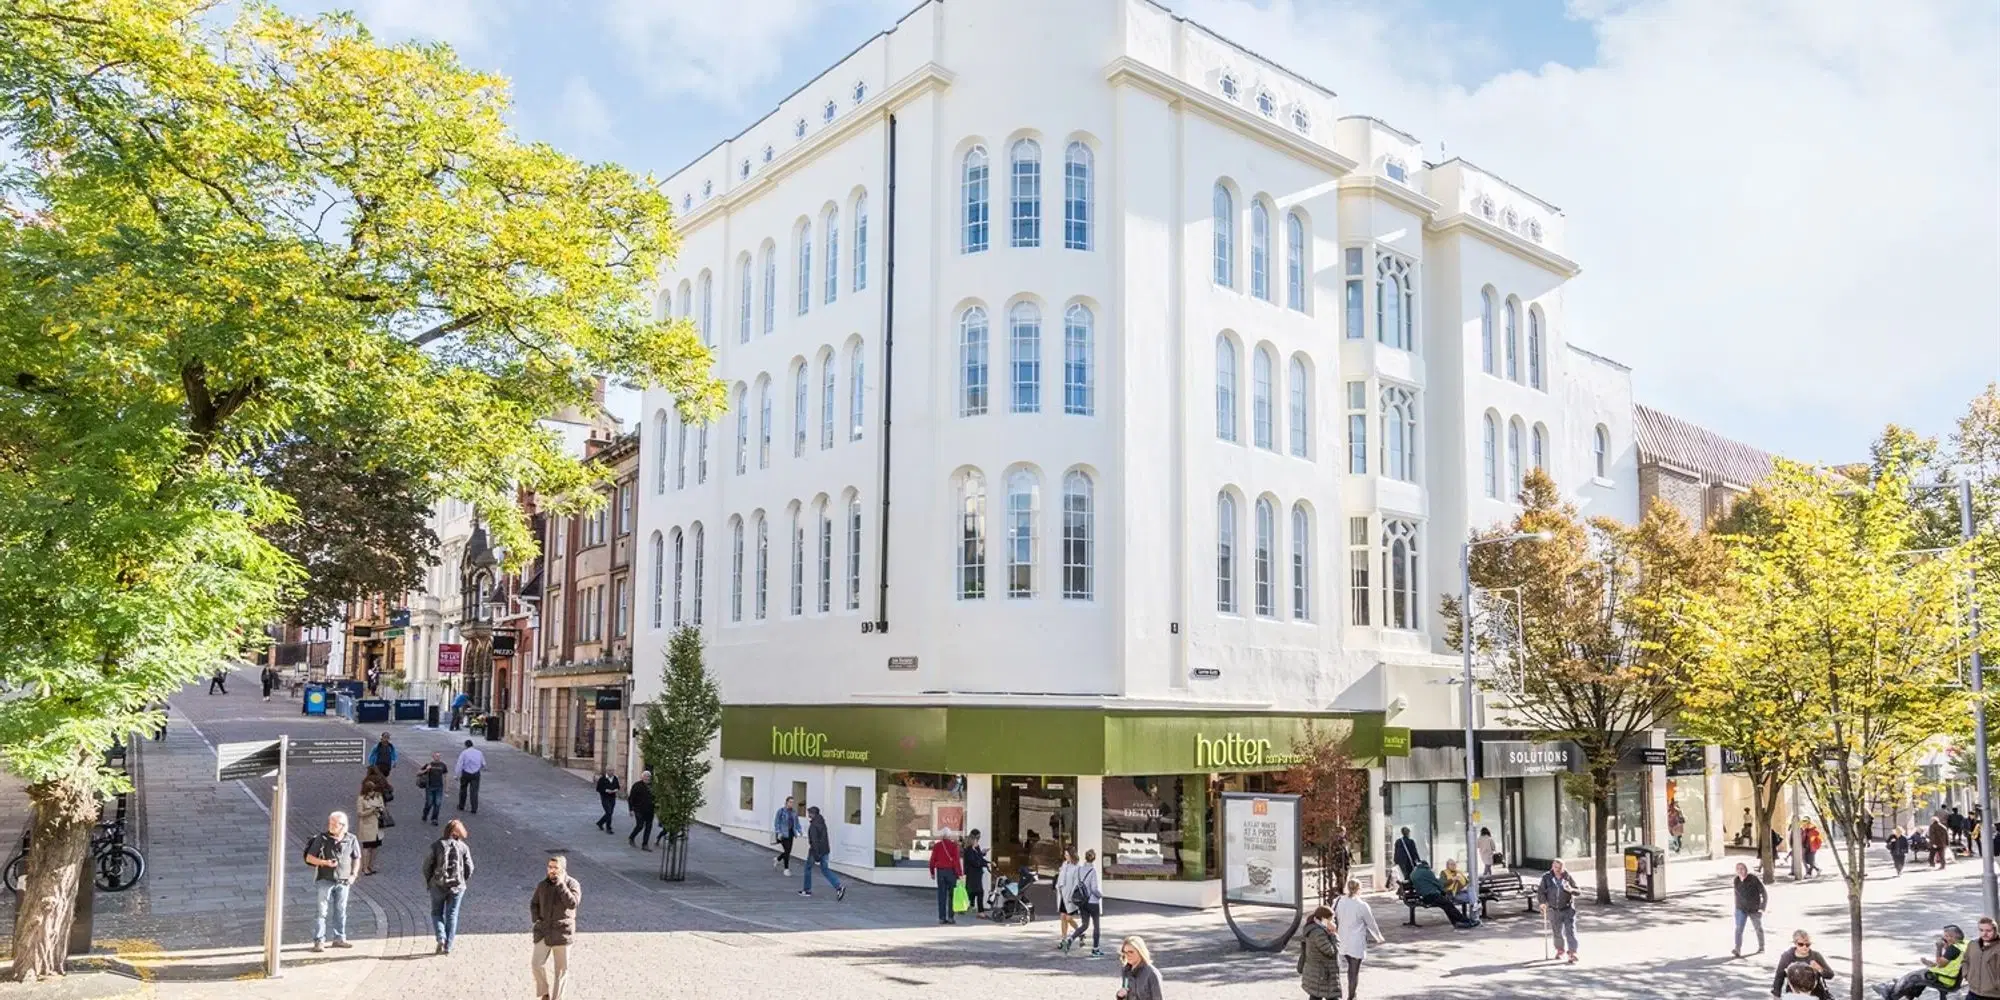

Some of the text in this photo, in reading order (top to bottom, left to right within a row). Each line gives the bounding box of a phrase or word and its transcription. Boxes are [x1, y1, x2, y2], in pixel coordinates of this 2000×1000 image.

[772, 725, 869, 763] hotter comfort concept
[1196, 733, 1272, 766] hotter
[1265, 753, 1293, 764] comfort
[1509, 750, 1568, 764] SOLUTIONS
[1124, 808, 1163, 817] DETAIL
